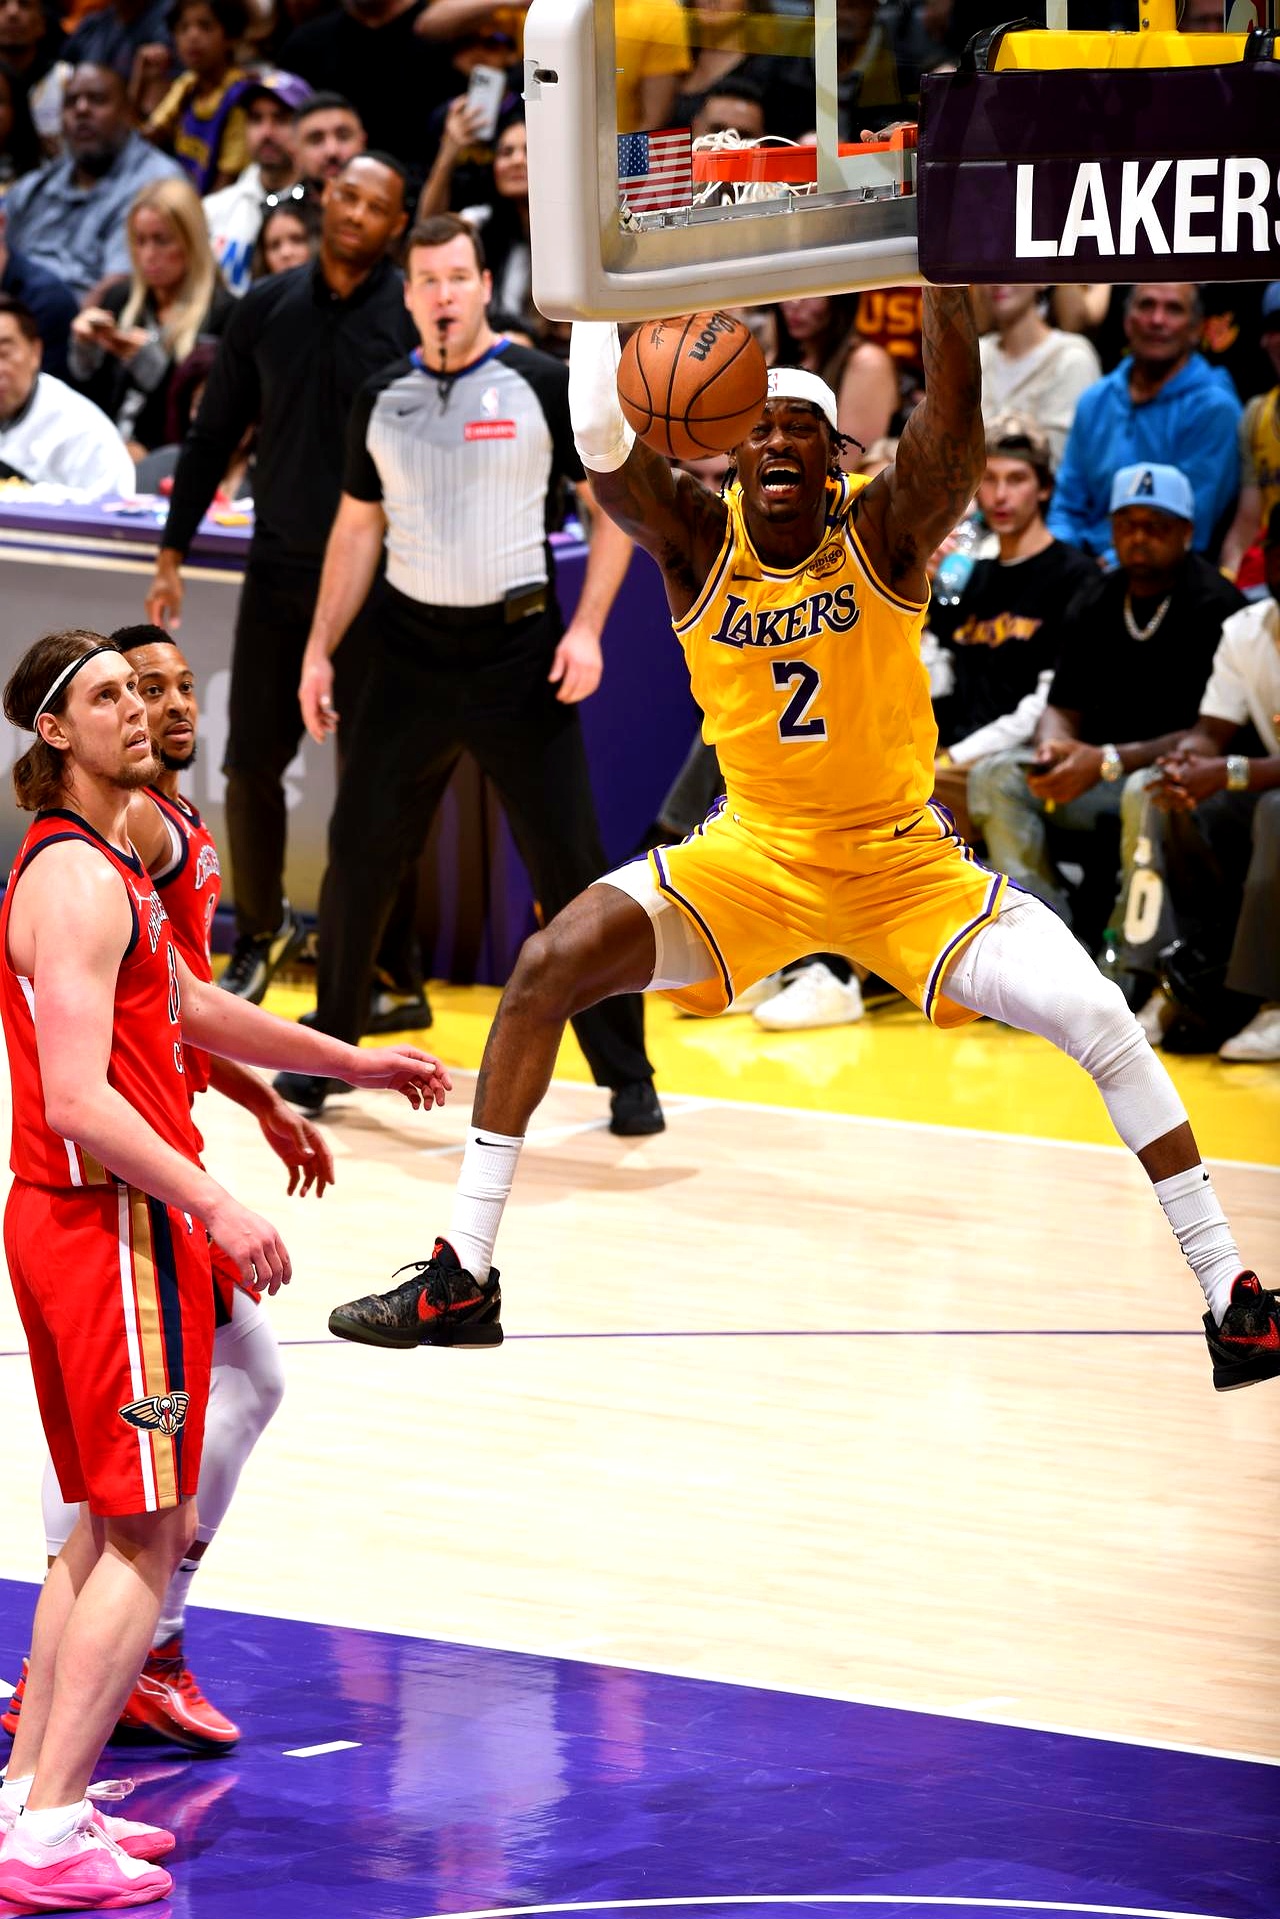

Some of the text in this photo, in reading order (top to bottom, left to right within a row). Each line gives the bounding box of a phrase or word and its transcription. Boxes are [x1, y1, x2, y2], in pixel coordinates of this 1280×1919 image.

[1015, 157, 1280, 258] LAKER
[856, 292, 923, 334] US
[711, 583, 861, 649] LAKERS
[770, 659, 829, 744] 2
